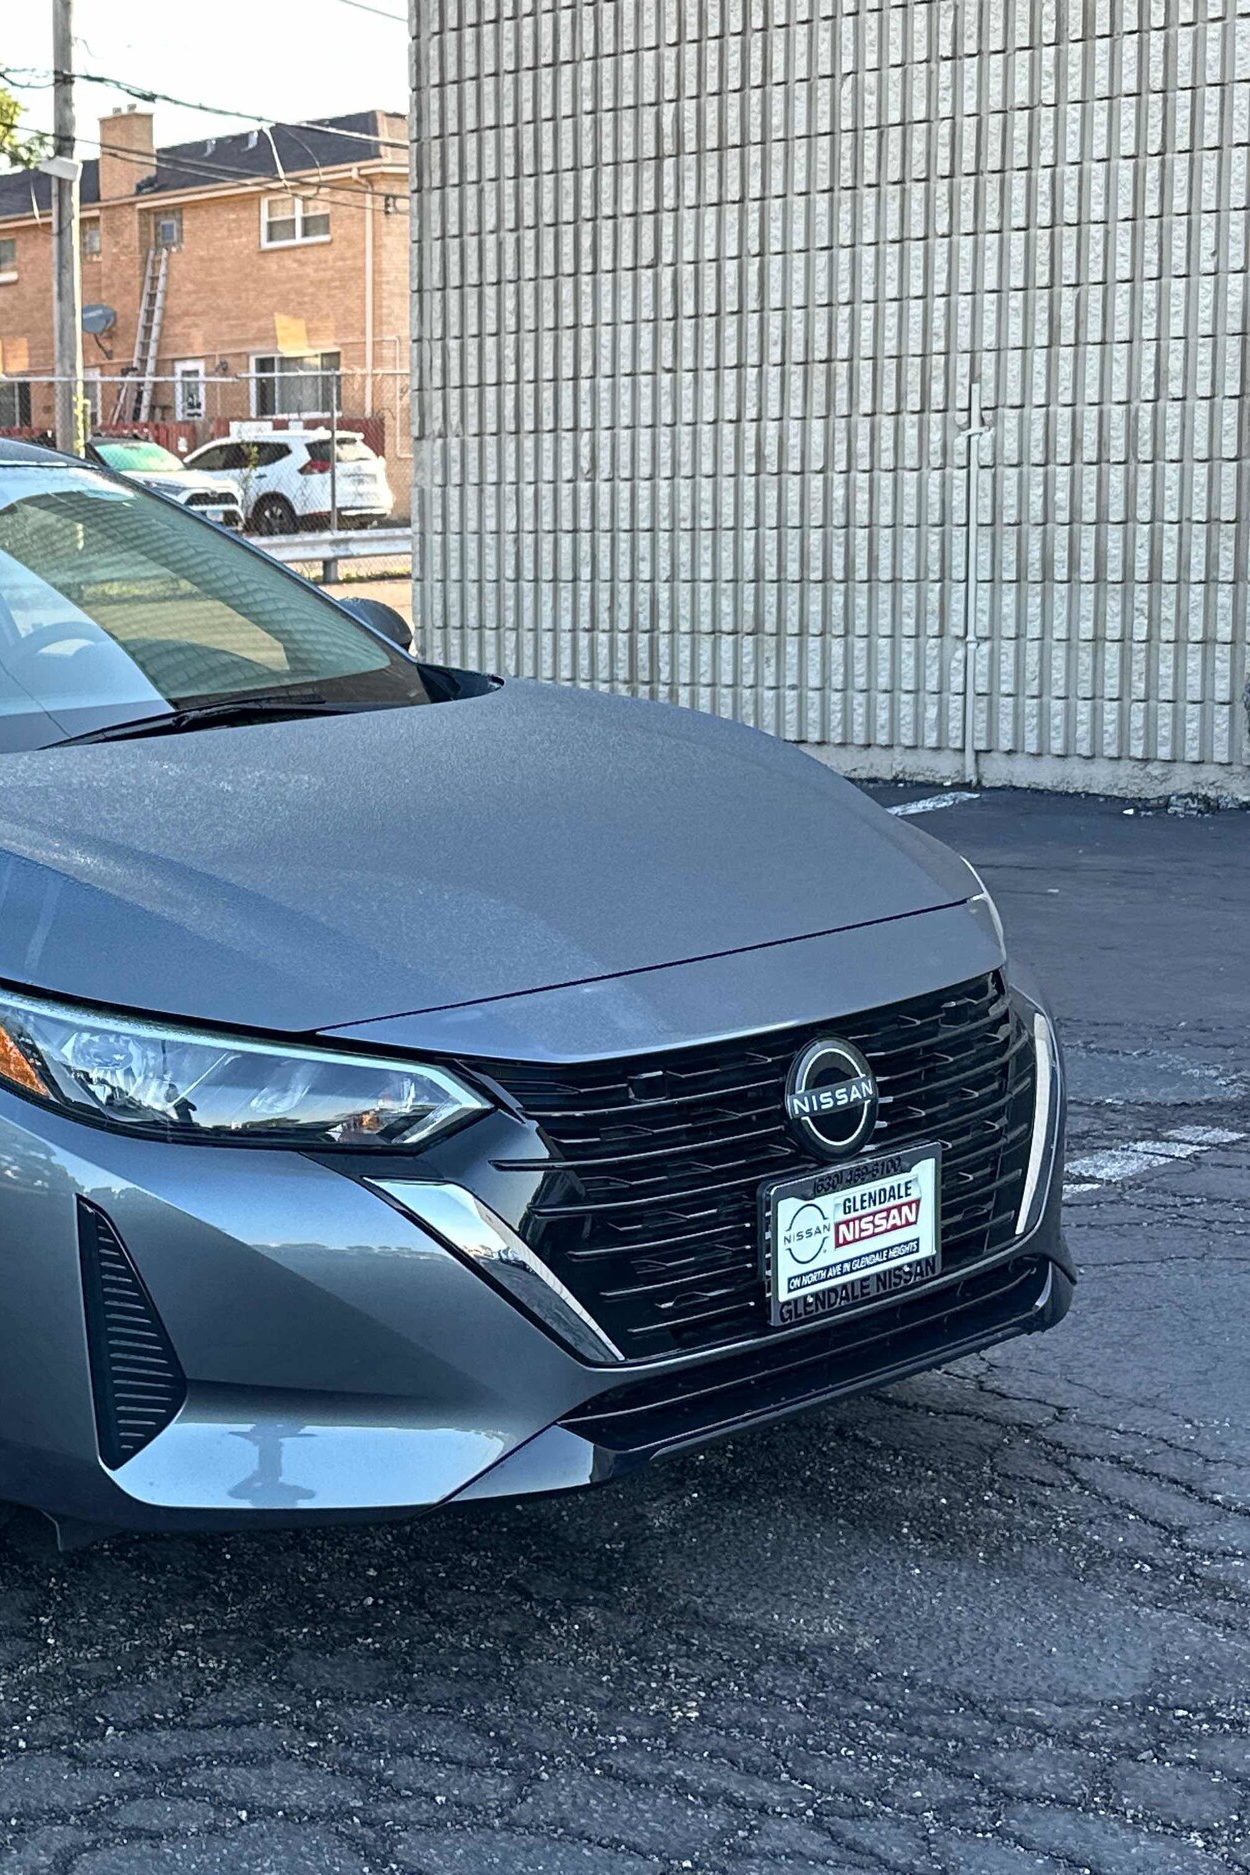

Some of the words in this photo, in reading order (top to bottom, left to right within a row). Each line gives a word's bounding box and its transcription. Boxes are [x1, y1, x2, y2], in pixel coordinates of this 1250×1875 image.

[792, 1079, 873, 1115] NISSAN
[842, 1180, 913, 1215] GLENDALE
[783, 1223, 831, 1246] NISSAN
[838, 1202, 919, 1245] NISSAN
[789, 1278, 801, 1291] ON
[801, 1270, 827, 1287] NORTH
[827, 1265, 842, 1279] AVE
[842, 1260, 852, 1273] IN
[851, 1249, 888, 1270] GLENDALE
[887, 1241, 918, 1259] HEIGHTS
[779, 1279, 871, 1324] GLENDALE
[876, 1258, 936, 1294] NISSAN
